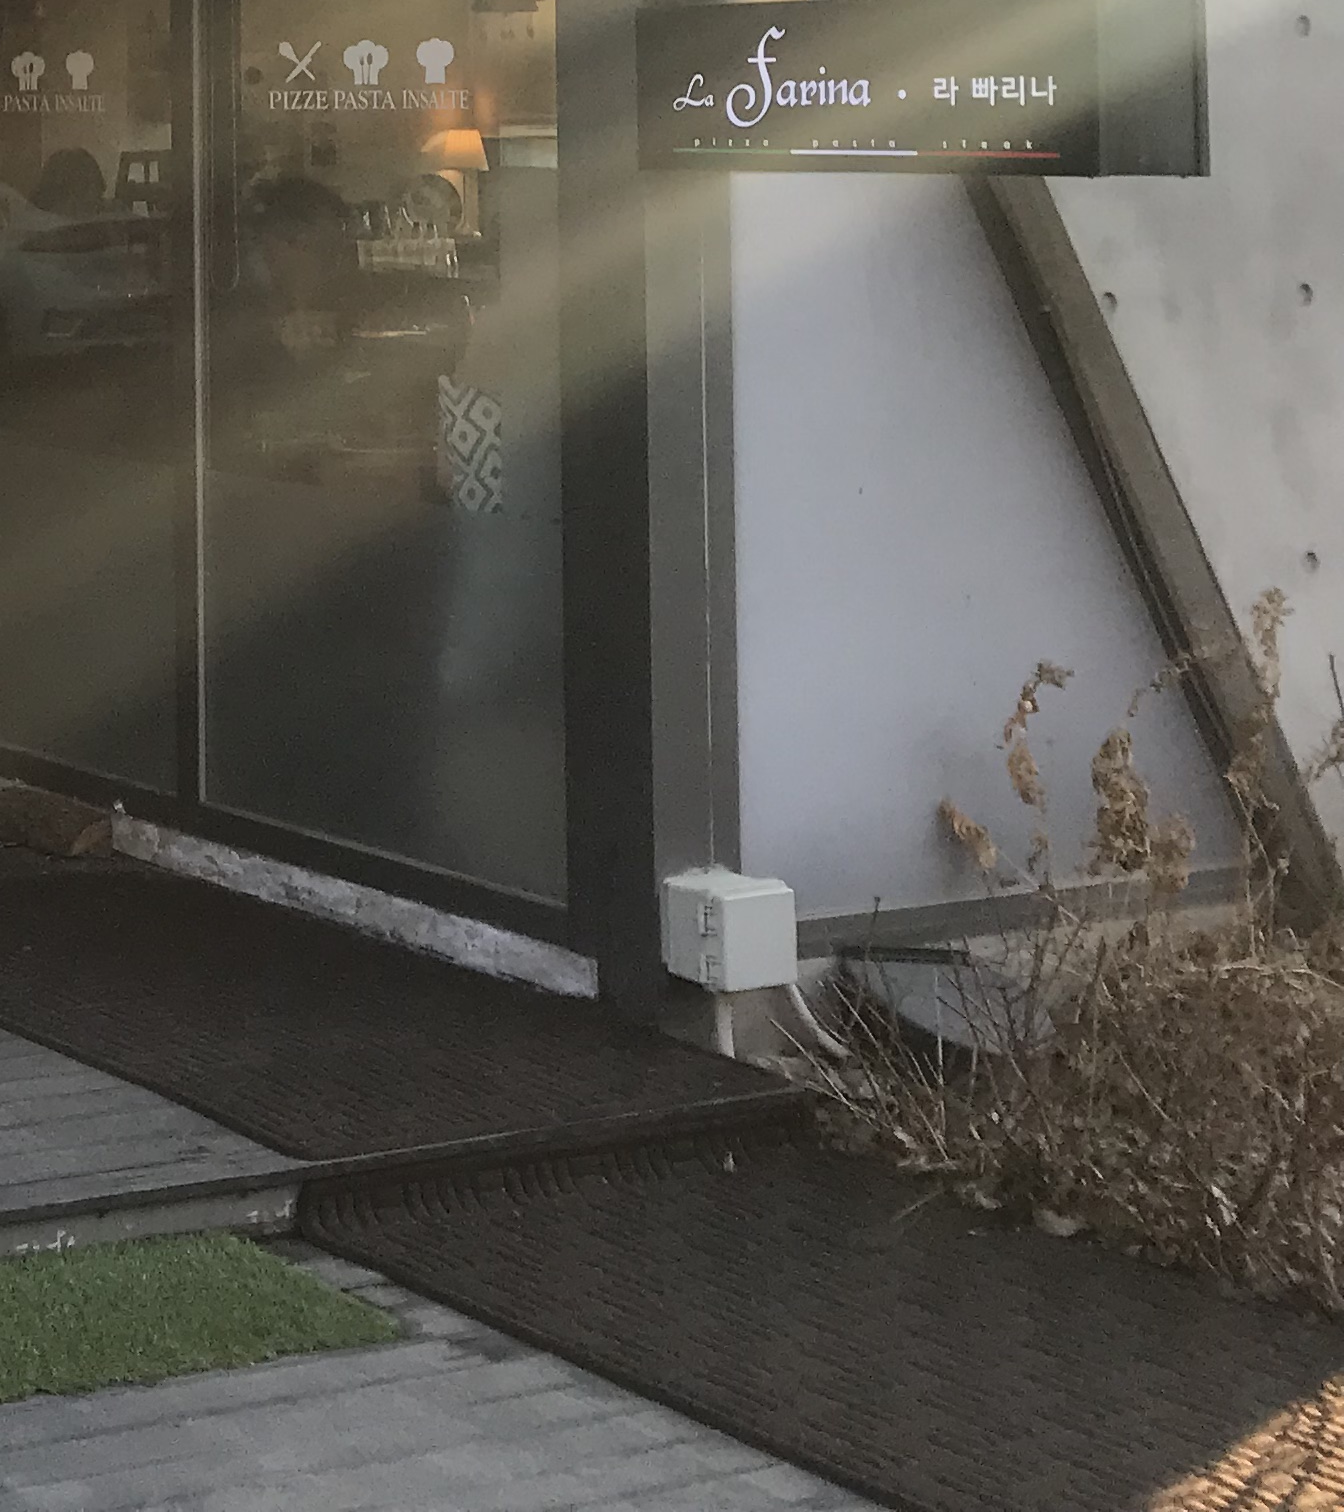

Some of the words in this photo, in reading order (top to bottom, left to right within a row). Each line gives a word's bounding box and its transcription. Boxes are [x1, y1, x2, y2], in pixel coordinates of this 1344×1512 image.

[269, 90, 330, 110] PIZZE
[334, 90, 397, 110] PASTA
[402, 90, 470, 110] INSALTE
[672, 73, 715, 112] La
[933, 76, 959, 106] 라
[971, 75, 1058, 106] 빠리나
[2, 95, 51, 113] PASTA
